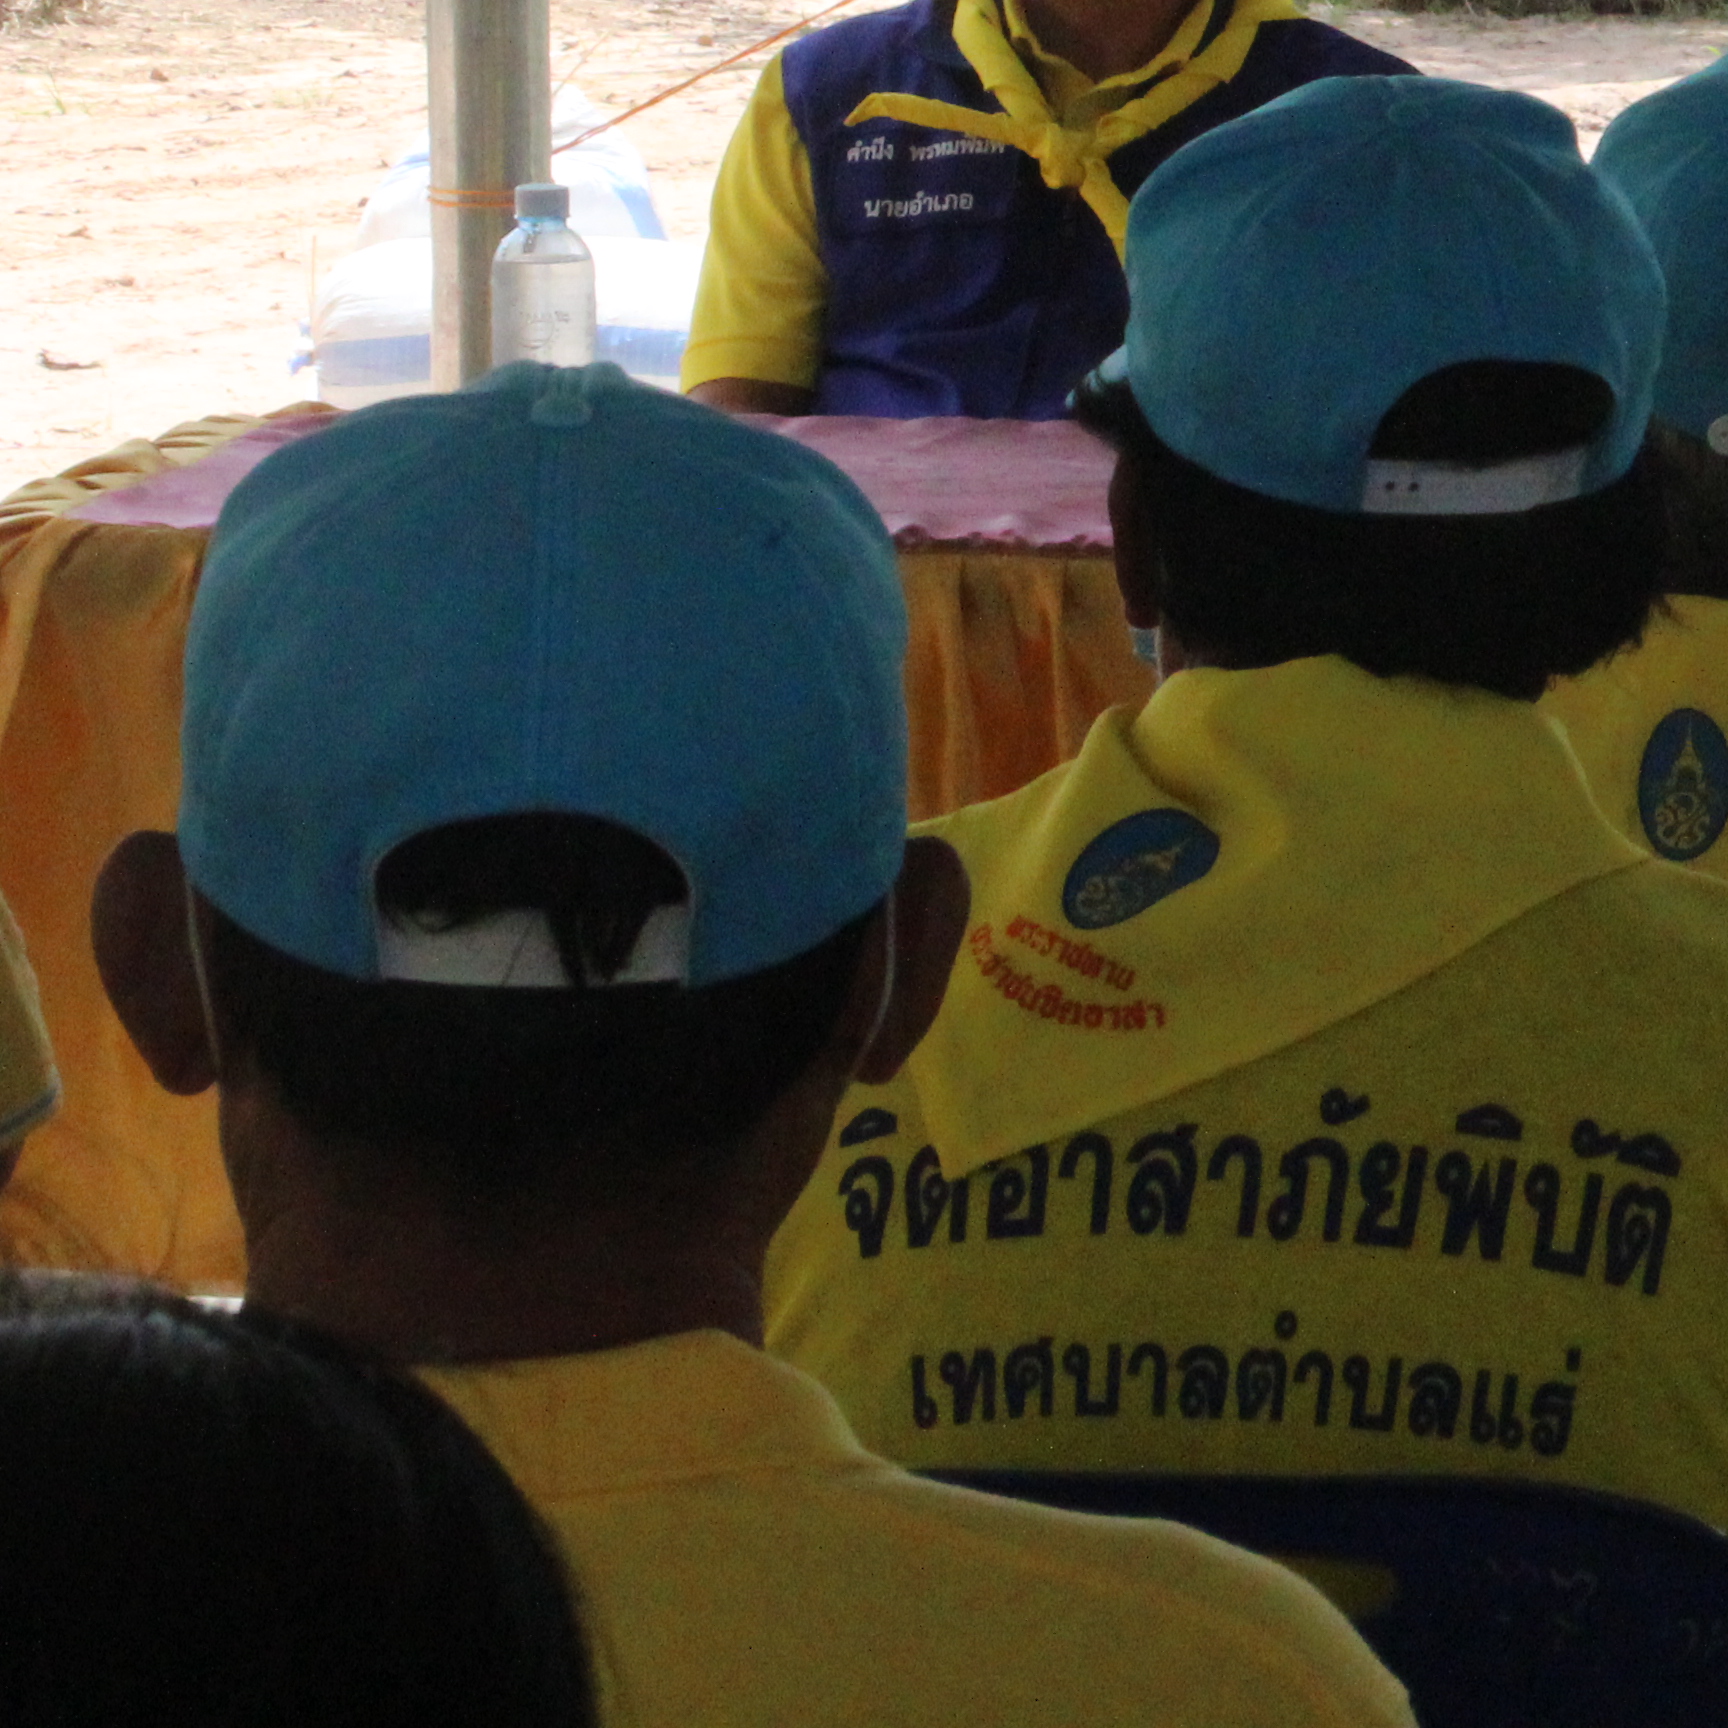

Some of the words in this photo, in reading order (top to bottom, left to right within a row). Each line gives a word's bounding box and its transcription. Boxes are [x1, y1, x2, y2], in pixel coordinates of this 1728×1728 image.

[863, 190, 975, 220] นายอำเภอ
[837, 1085, 1683, 1296] จิตอาสาภัยพิบัติ
[909, 1308, 1584, 1458] เทศบาลตำบลแร่
